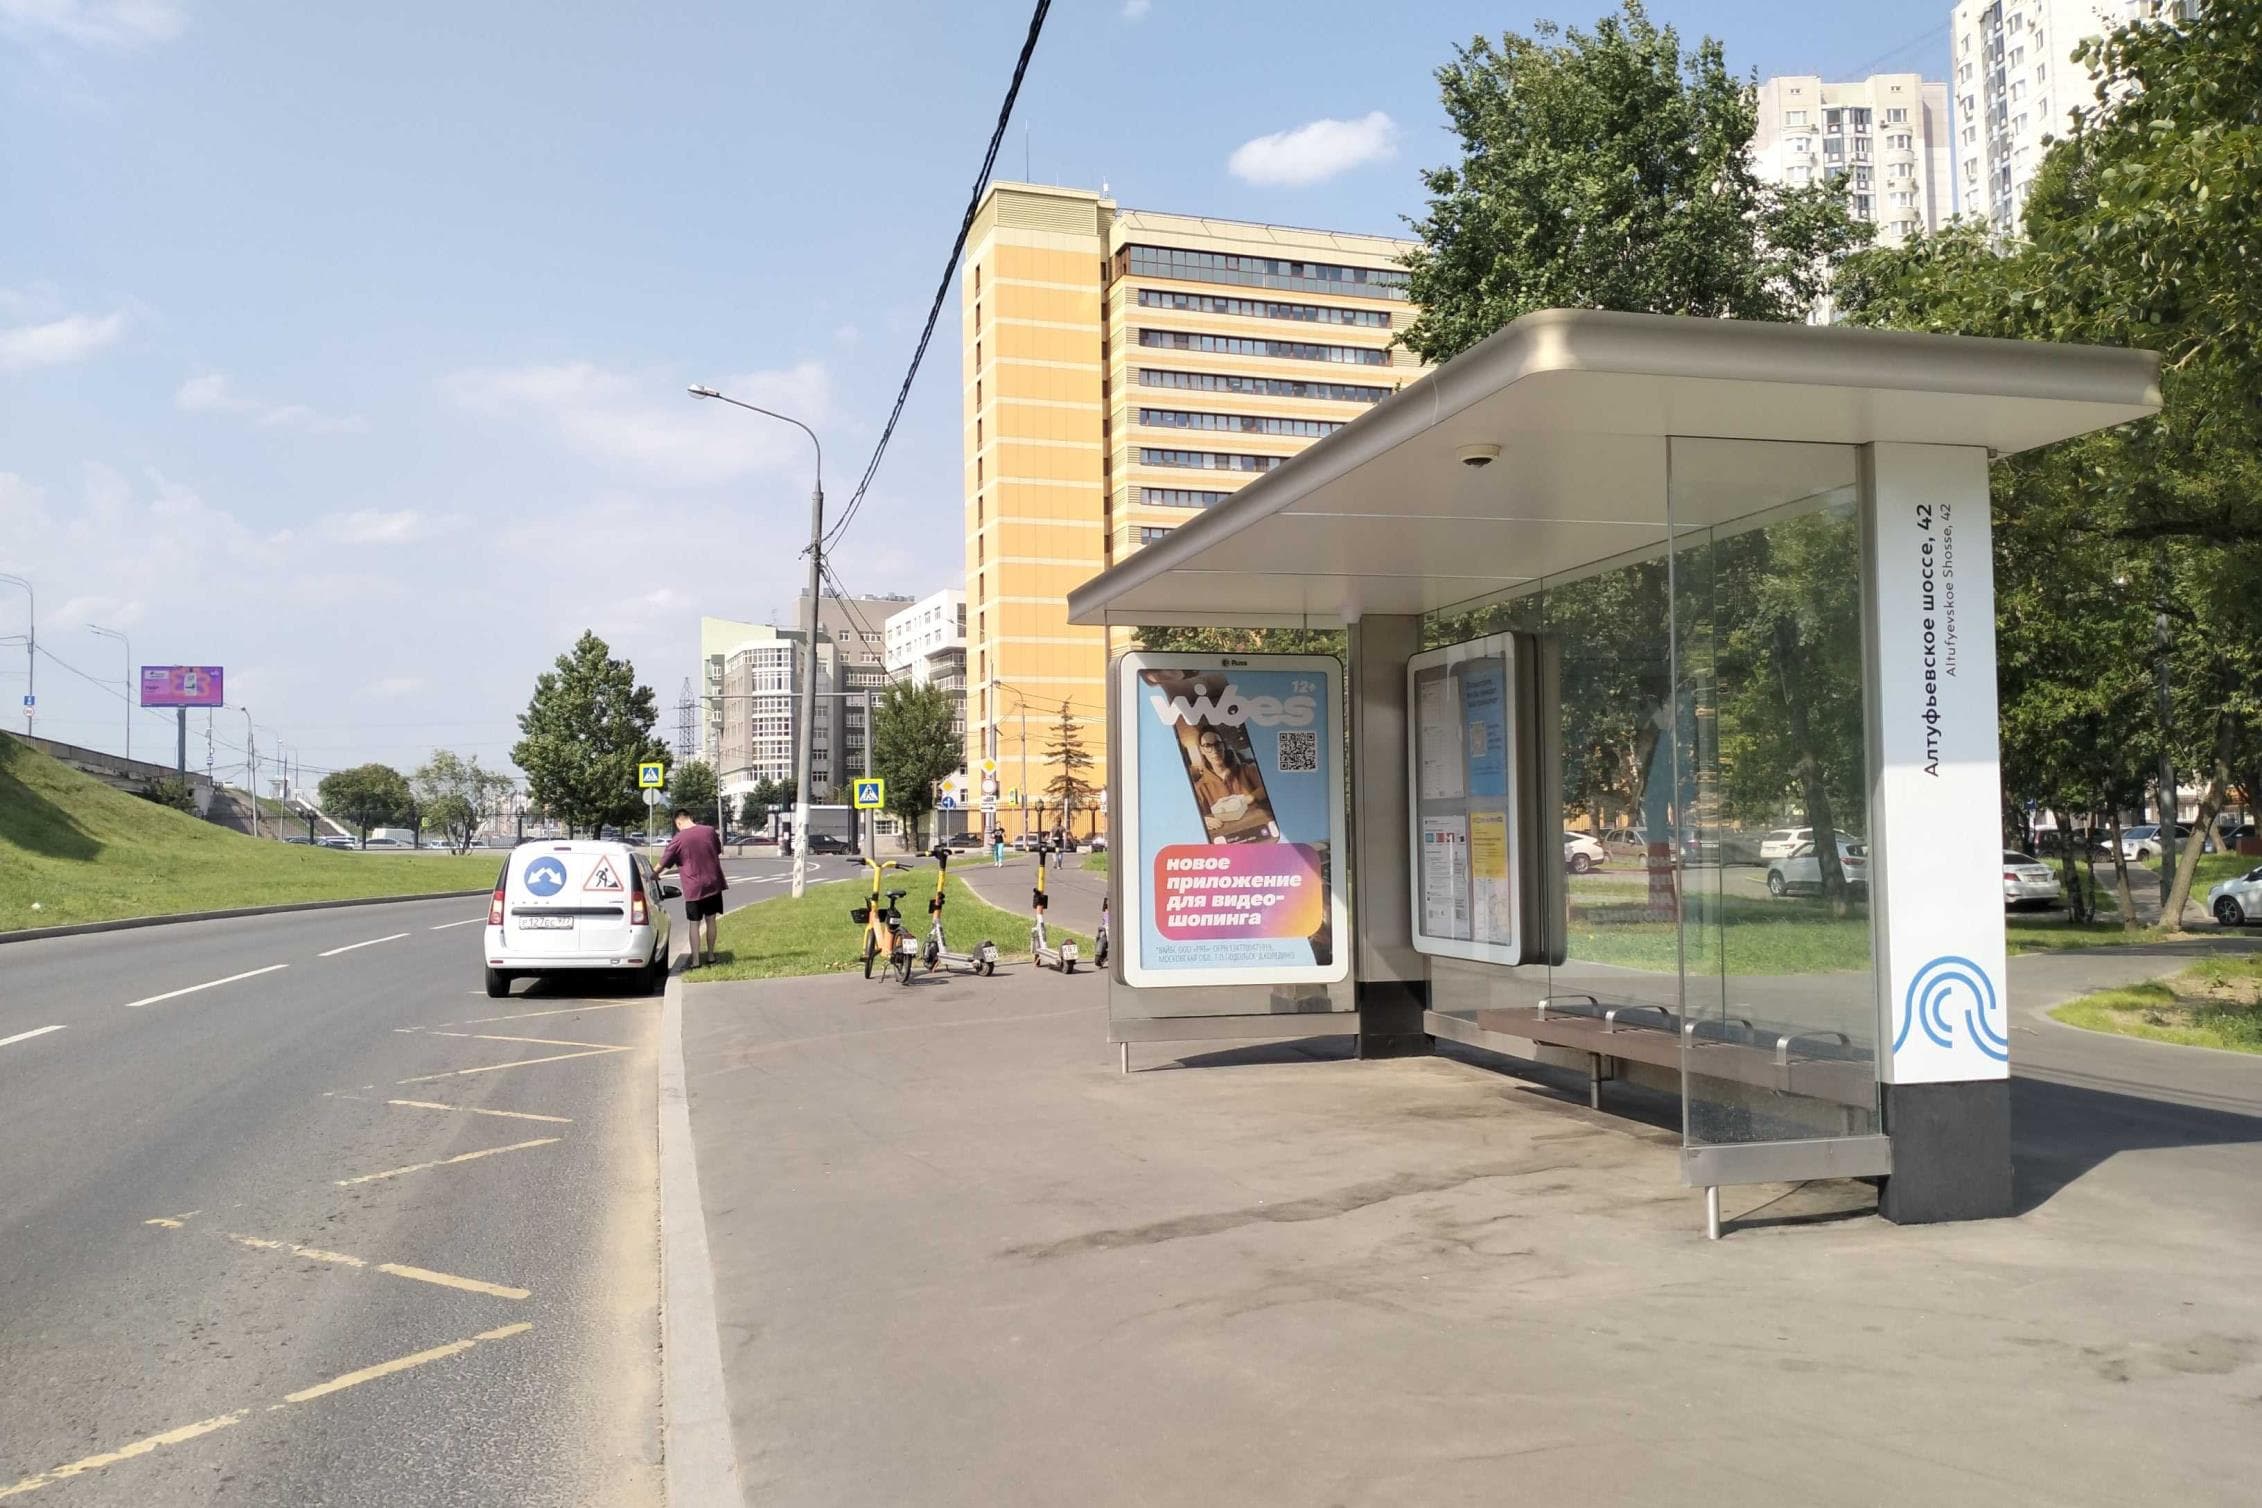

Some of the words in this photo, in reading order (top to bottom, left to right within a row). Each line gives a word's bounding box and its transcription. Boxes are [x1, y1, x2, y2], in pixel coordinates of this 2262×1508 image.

[1916, 504, 1932, 530] 42
[1940, 504, 1952, 521] 42
[1942, 525, 1954, 577] Shosse,
[1921, 537, 1936, 611] шоссе,
[1944, 582, 1958, 677] Altufyevskoe
[1150, 684, 1316, 728] vibes
[1921, 618, 1942, 777] Алтуфьевское
[1166, 857, 1231, 871] новое
[1166, 874, 1302, 894] приложение
[1166, 895, 1207, 911] для
[1211, 893, 1285, 909] видео-
[1168, 912, 1262, 927] шопинга
